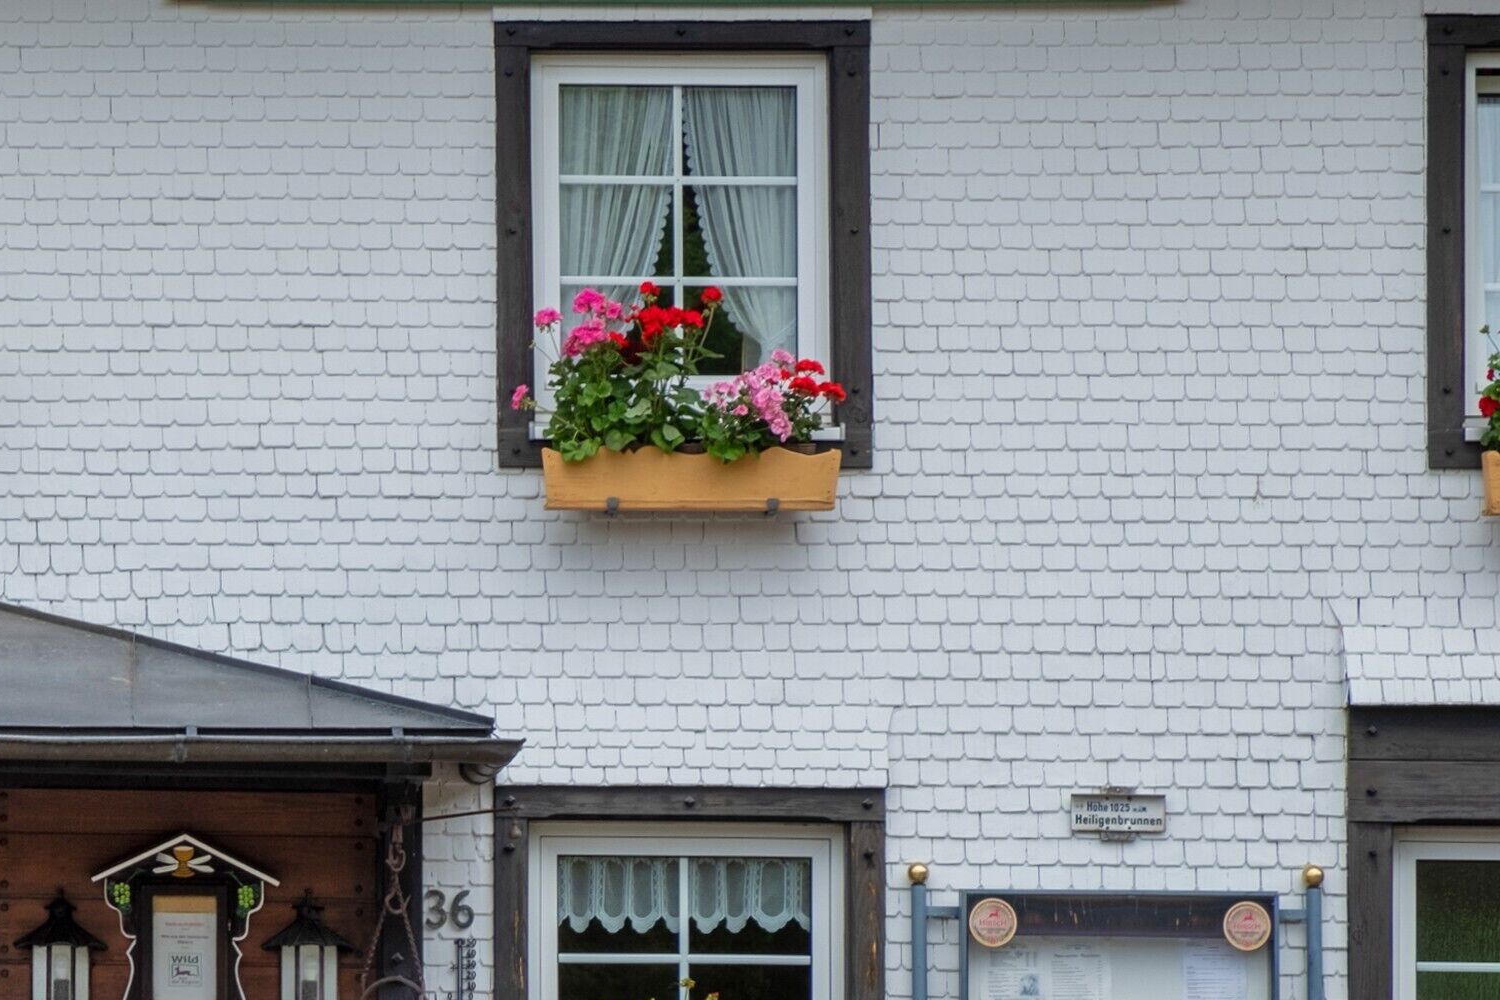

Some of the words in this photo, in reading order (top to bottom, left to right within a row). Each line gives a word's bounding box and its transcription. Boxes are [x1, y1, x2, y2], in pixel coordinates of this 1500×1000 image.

[1110, 803, 1131, 812] 1025
[1075, 814, 1162, 827] Heiligenbrunnen
[425, 889, 475, 930] 36
[171, 955, 199, 963] Wild
